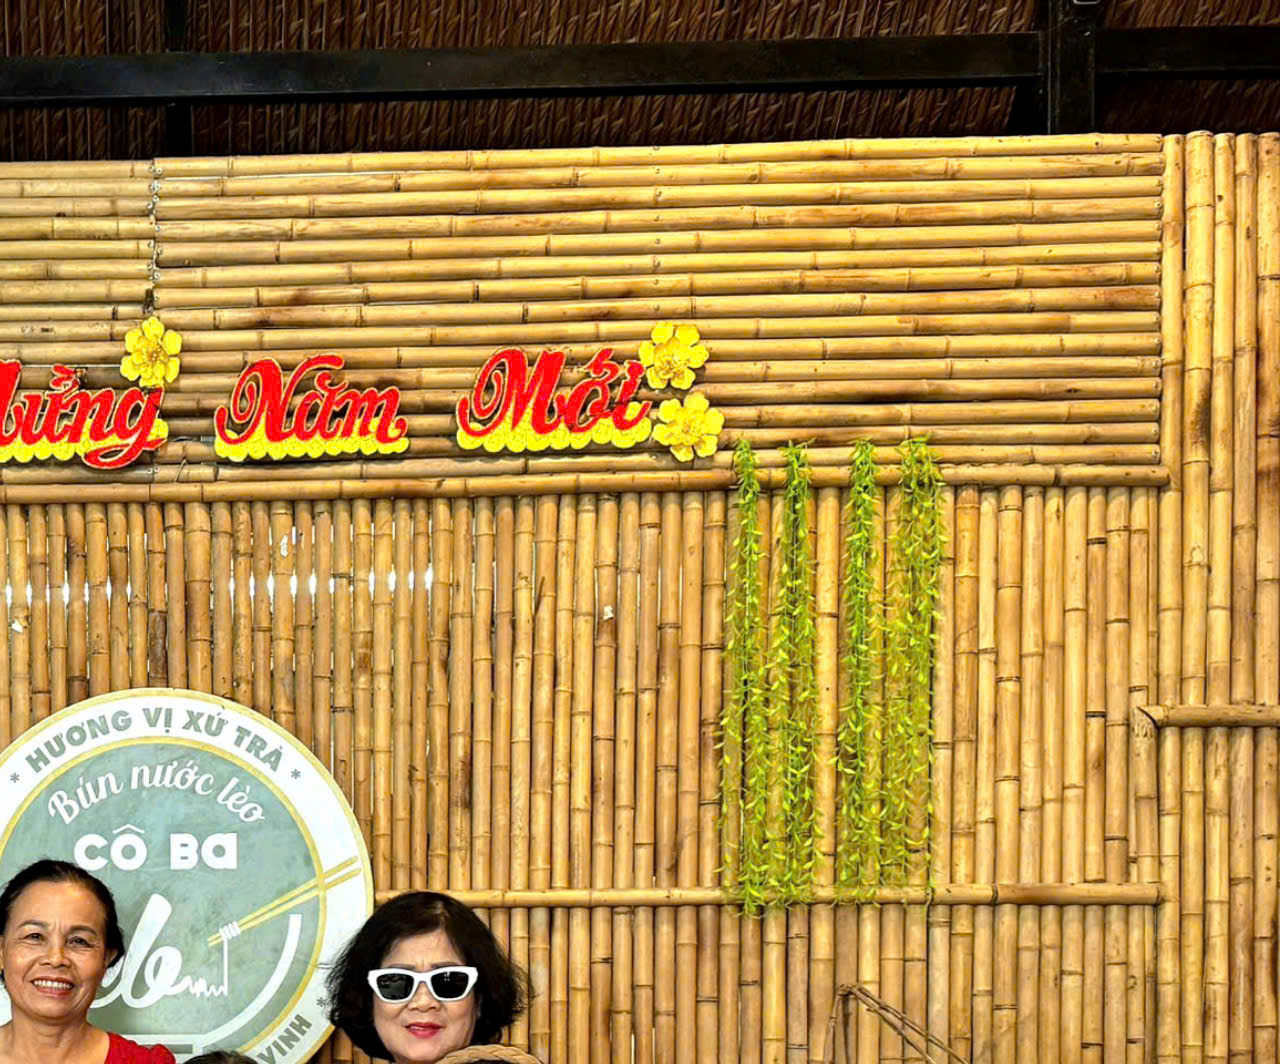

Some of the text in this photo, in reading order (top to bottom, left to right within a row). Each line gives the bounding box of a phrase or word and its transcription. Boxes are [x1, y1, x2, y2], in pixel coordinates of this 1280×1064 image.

[215, 354, 408, 445] Năm
[25, 710, 132, 773] HƯƠNG
[142, 707, 173, 733] VỊ
[182, 710, 229, 737] XỨ
[47, 760, 265, 825] Bún nước lèo
[73, 823, 148, 871] CÔ
